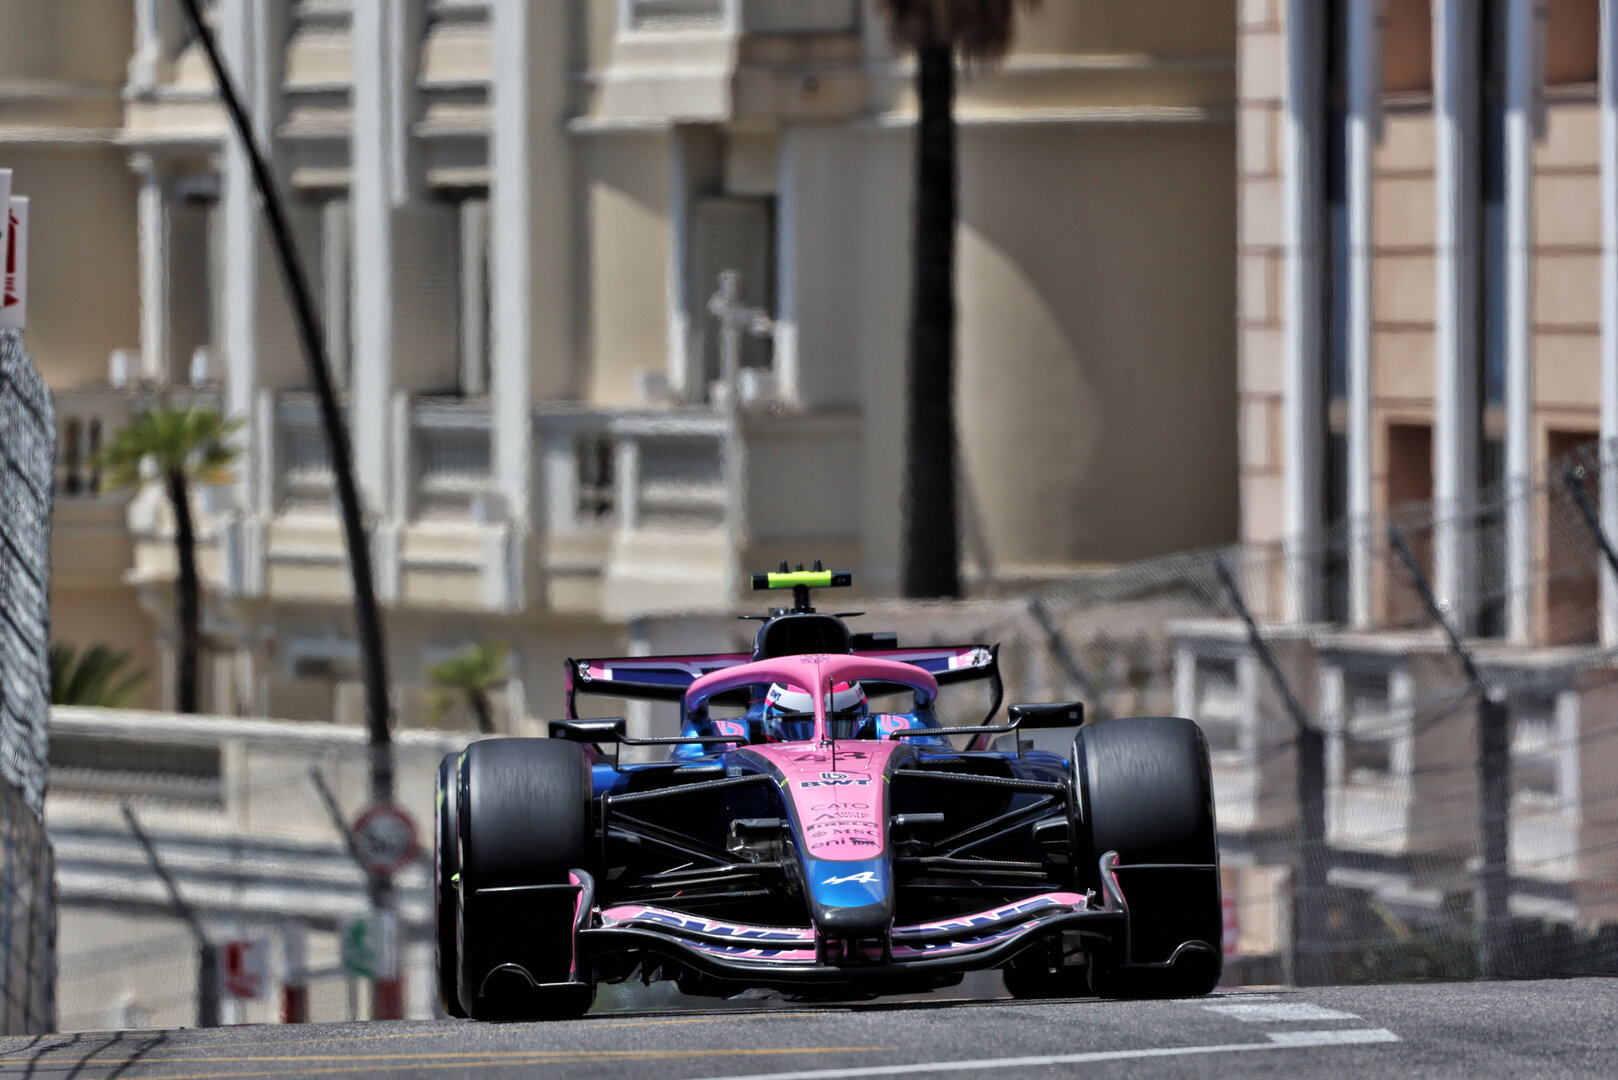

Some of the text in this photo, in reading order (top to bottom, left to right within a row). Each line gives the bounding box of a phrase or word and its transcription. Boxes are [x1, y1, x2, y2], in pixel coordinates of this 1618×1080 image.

[800, 779, 872, 788] BWT
[811, 802, 869, 811] CATO
[834, 828, 880, 838] MSC
[811, 837, 845, 849] eni
